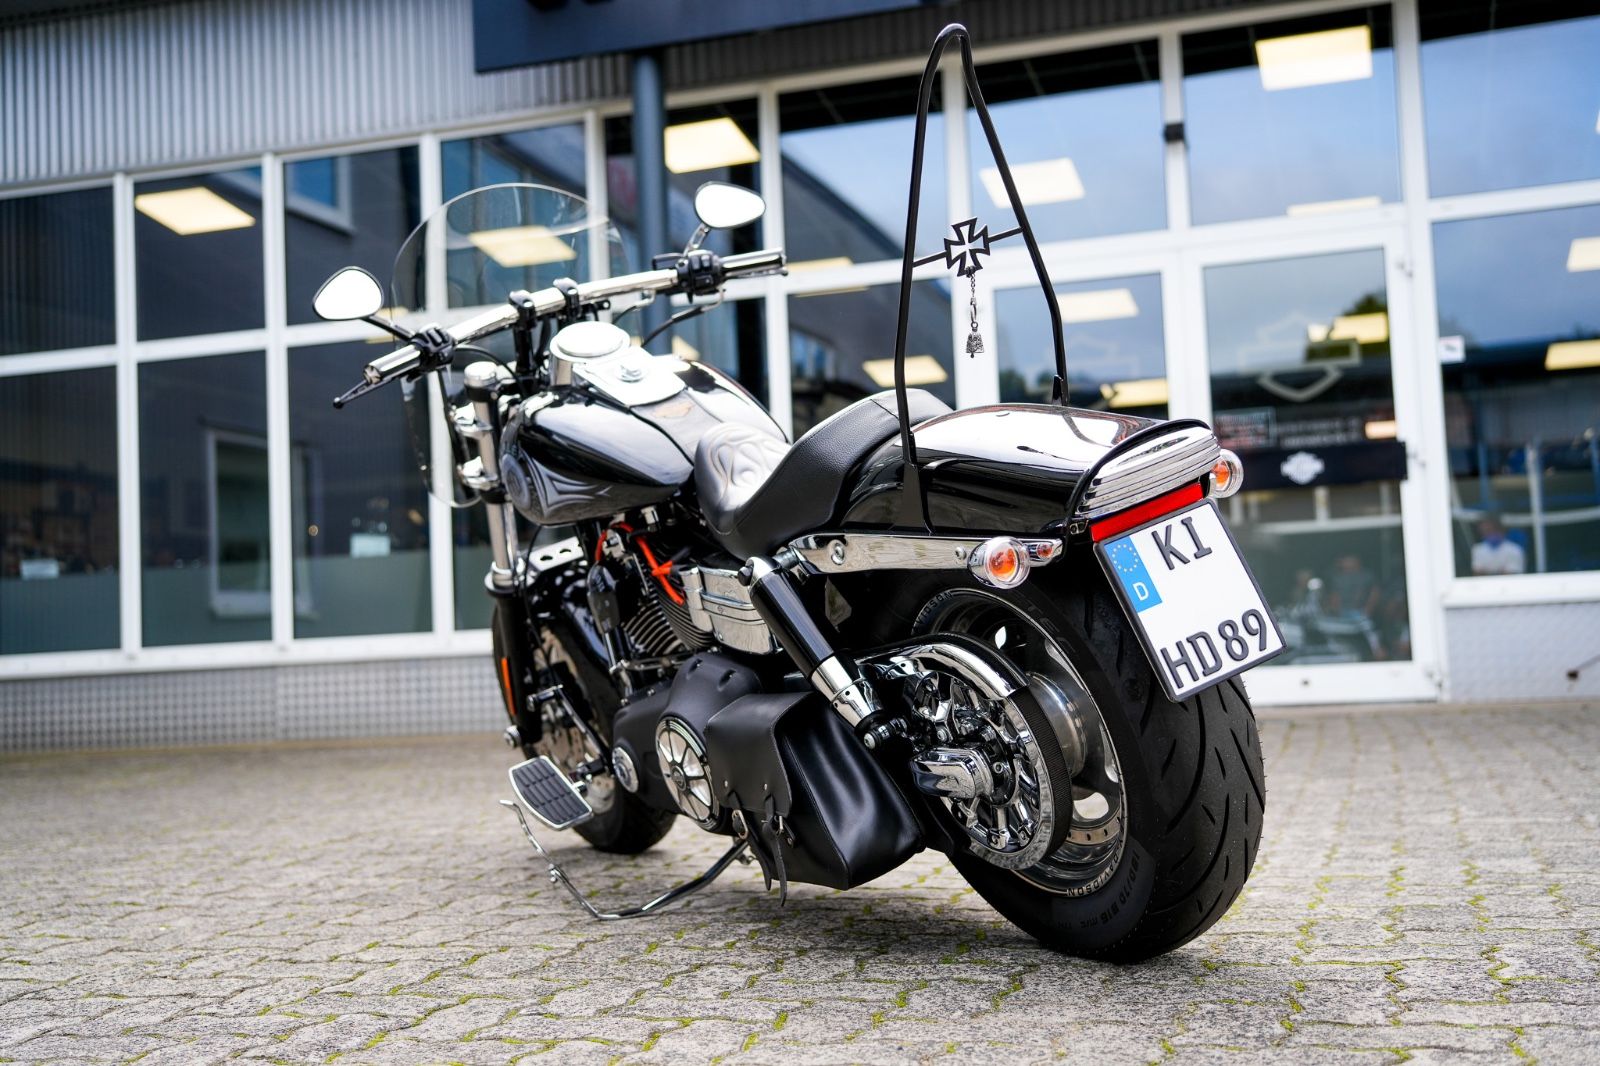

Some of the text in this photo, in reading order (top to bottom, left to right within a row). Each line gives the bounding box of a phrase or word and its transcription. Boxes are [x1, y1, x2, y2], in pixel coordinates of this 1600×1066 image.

[1151, 516, 1213, 571] KI
[1133, 581, 1149, 601] D
[1160, 608, 1267, 689] HD89
